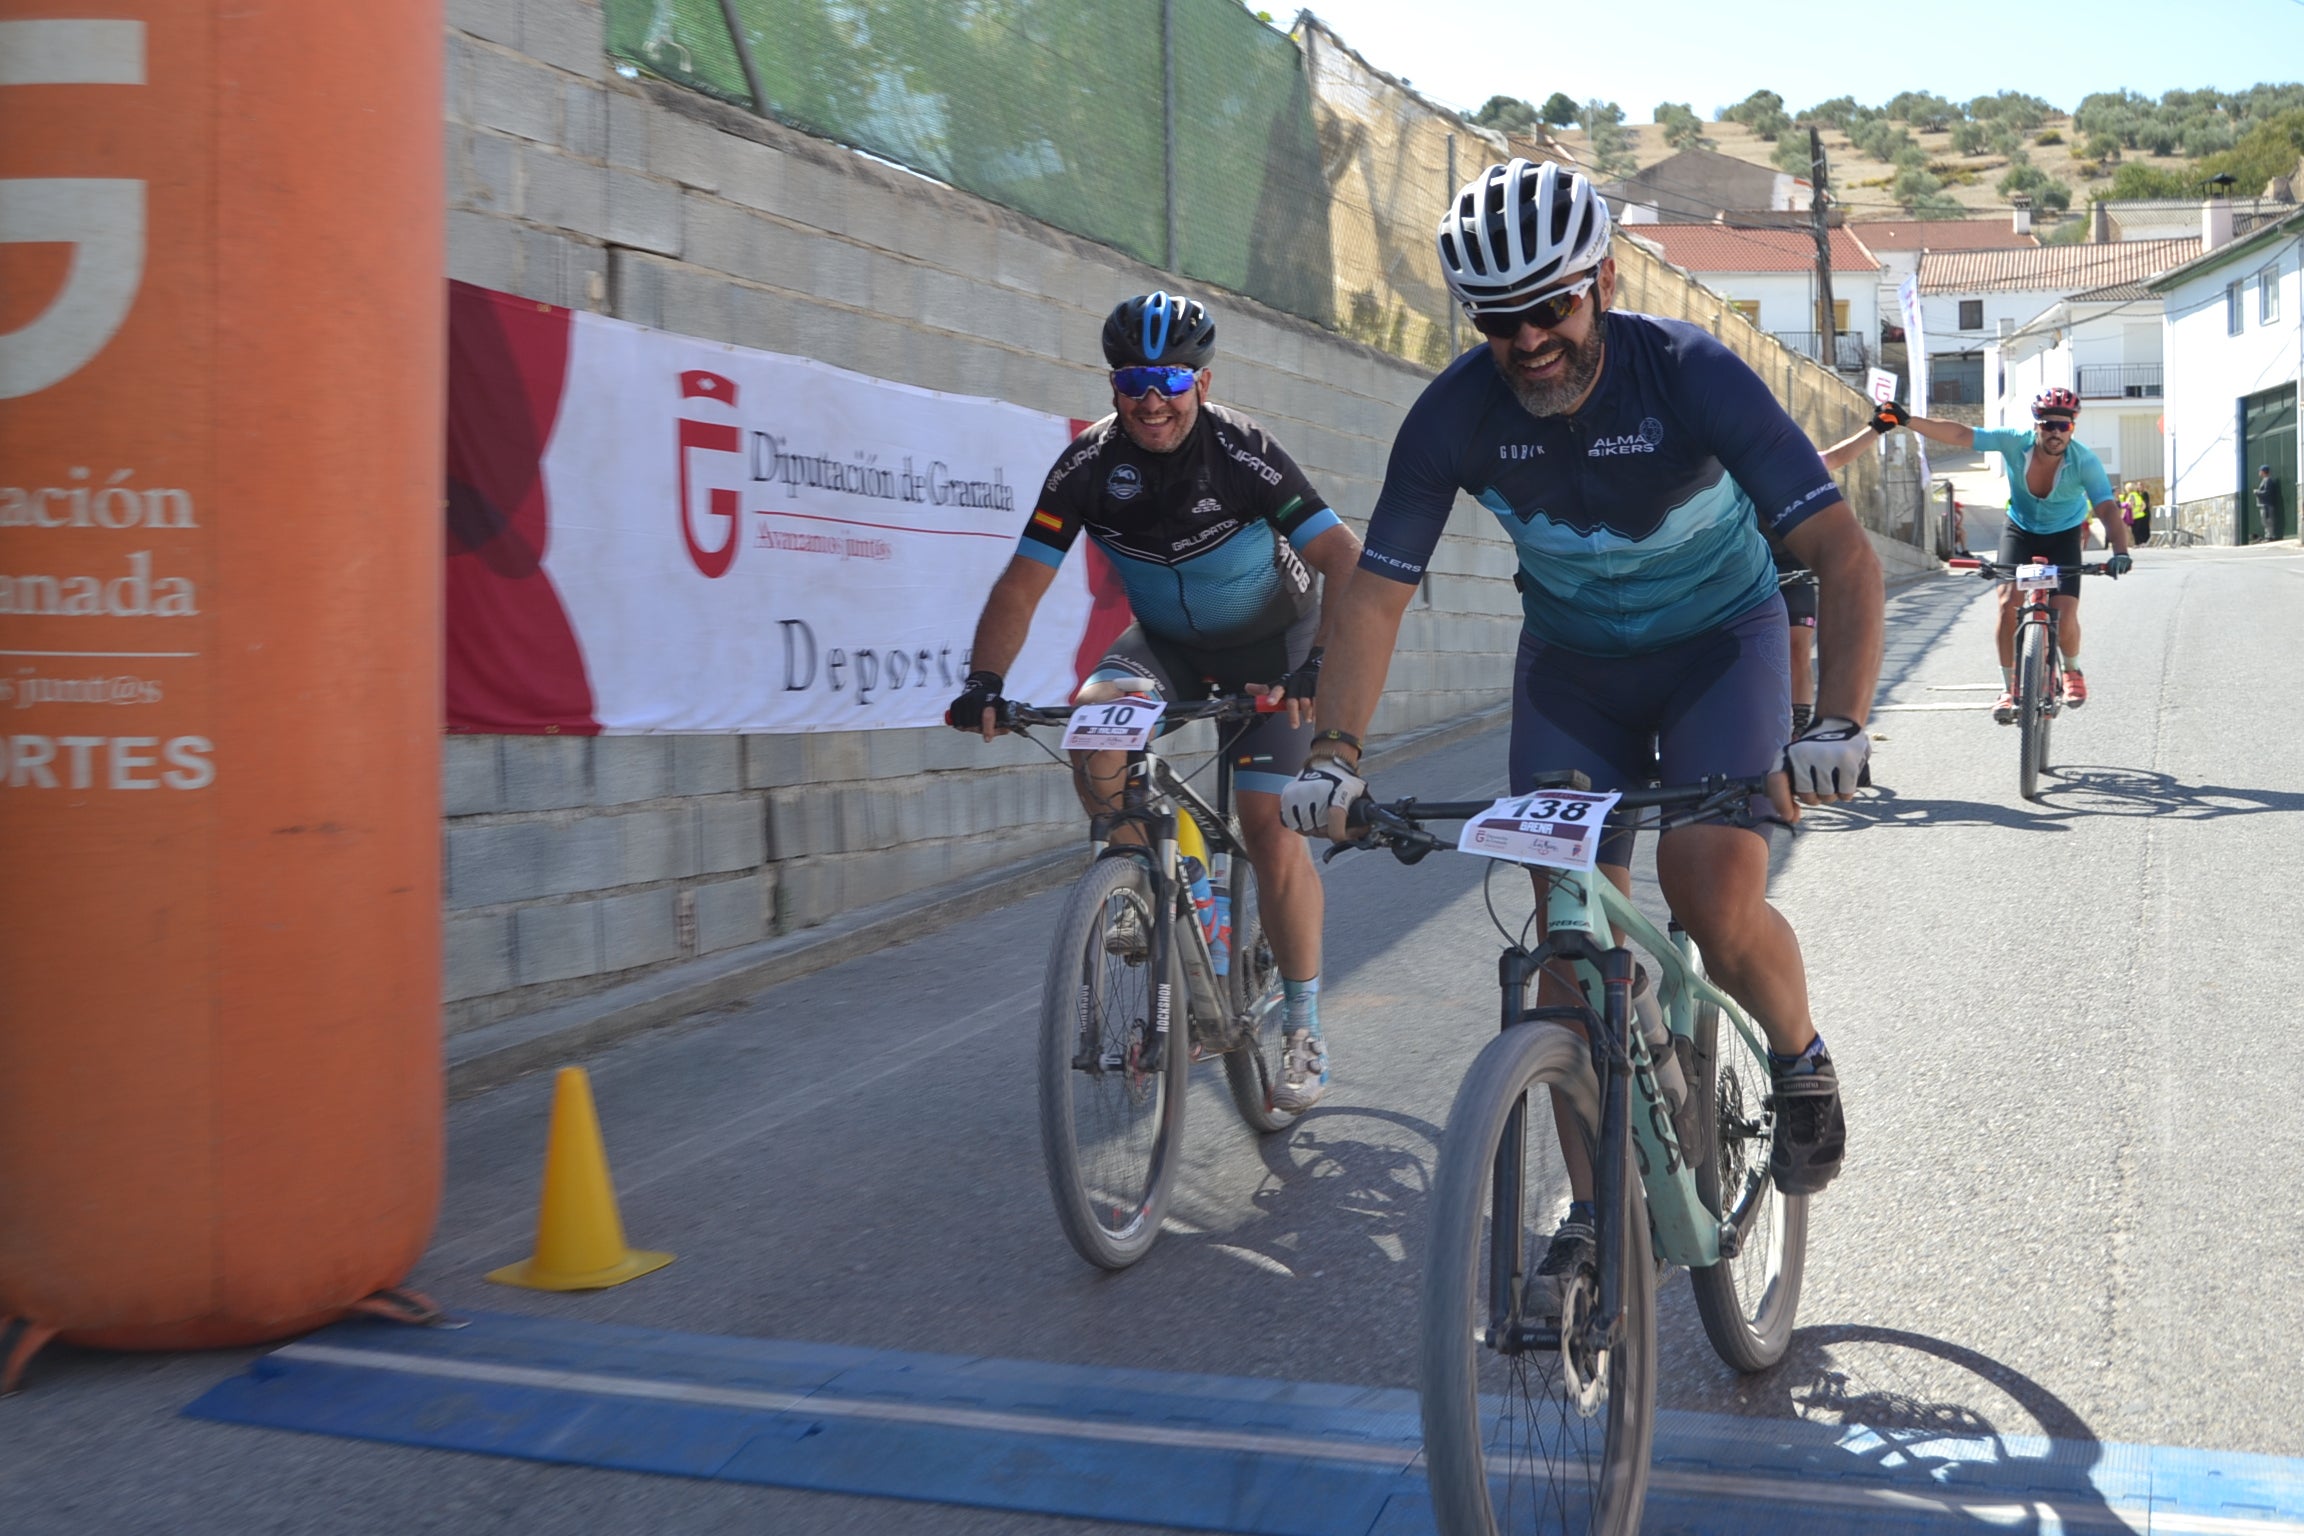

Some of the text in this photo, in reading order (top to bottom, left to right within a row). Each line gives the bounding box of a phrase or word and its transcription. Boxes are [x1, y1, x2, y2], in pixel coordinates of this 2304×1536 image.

[1588, 443, 1655, 457] BIKERS
[1593, 434, 1647, 448] ALMA
[749, 430, 1015, 511] Diputación de Granada
[1365, 549, 1422, 573] BIKERS
[1101, 706, 1135, 726] 10
[0, 735, 216, 790] RTES
[1510, 799, 1592, 821] 138
[1156, 983, 1171, 1033] ROCKSHOX
